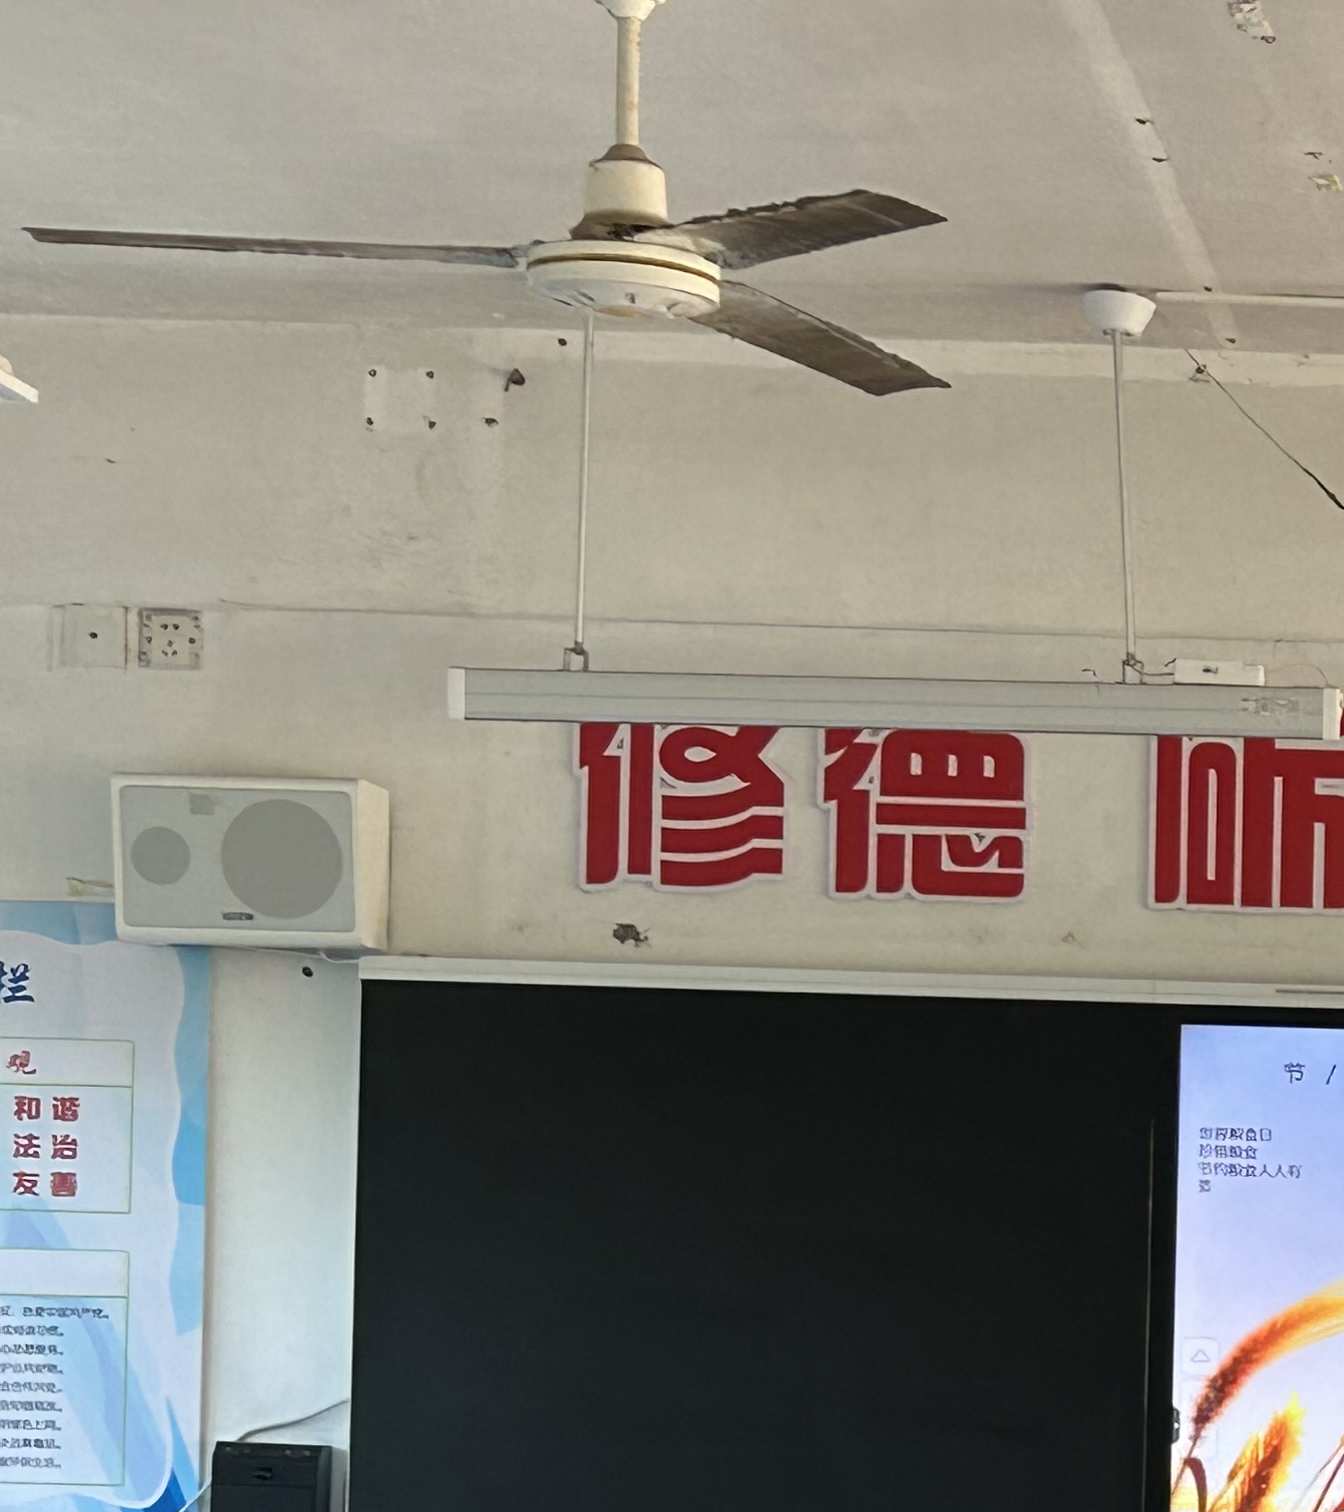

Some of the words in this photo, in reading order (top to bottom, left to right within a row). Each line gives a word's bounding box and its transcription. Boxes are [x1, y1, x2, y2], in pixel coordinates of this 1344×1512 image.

[576, 722, 1029, 899] 修德
[13, 1095, 81, 1122] 和谐
[12, 1133, 79, 1160] 法治
